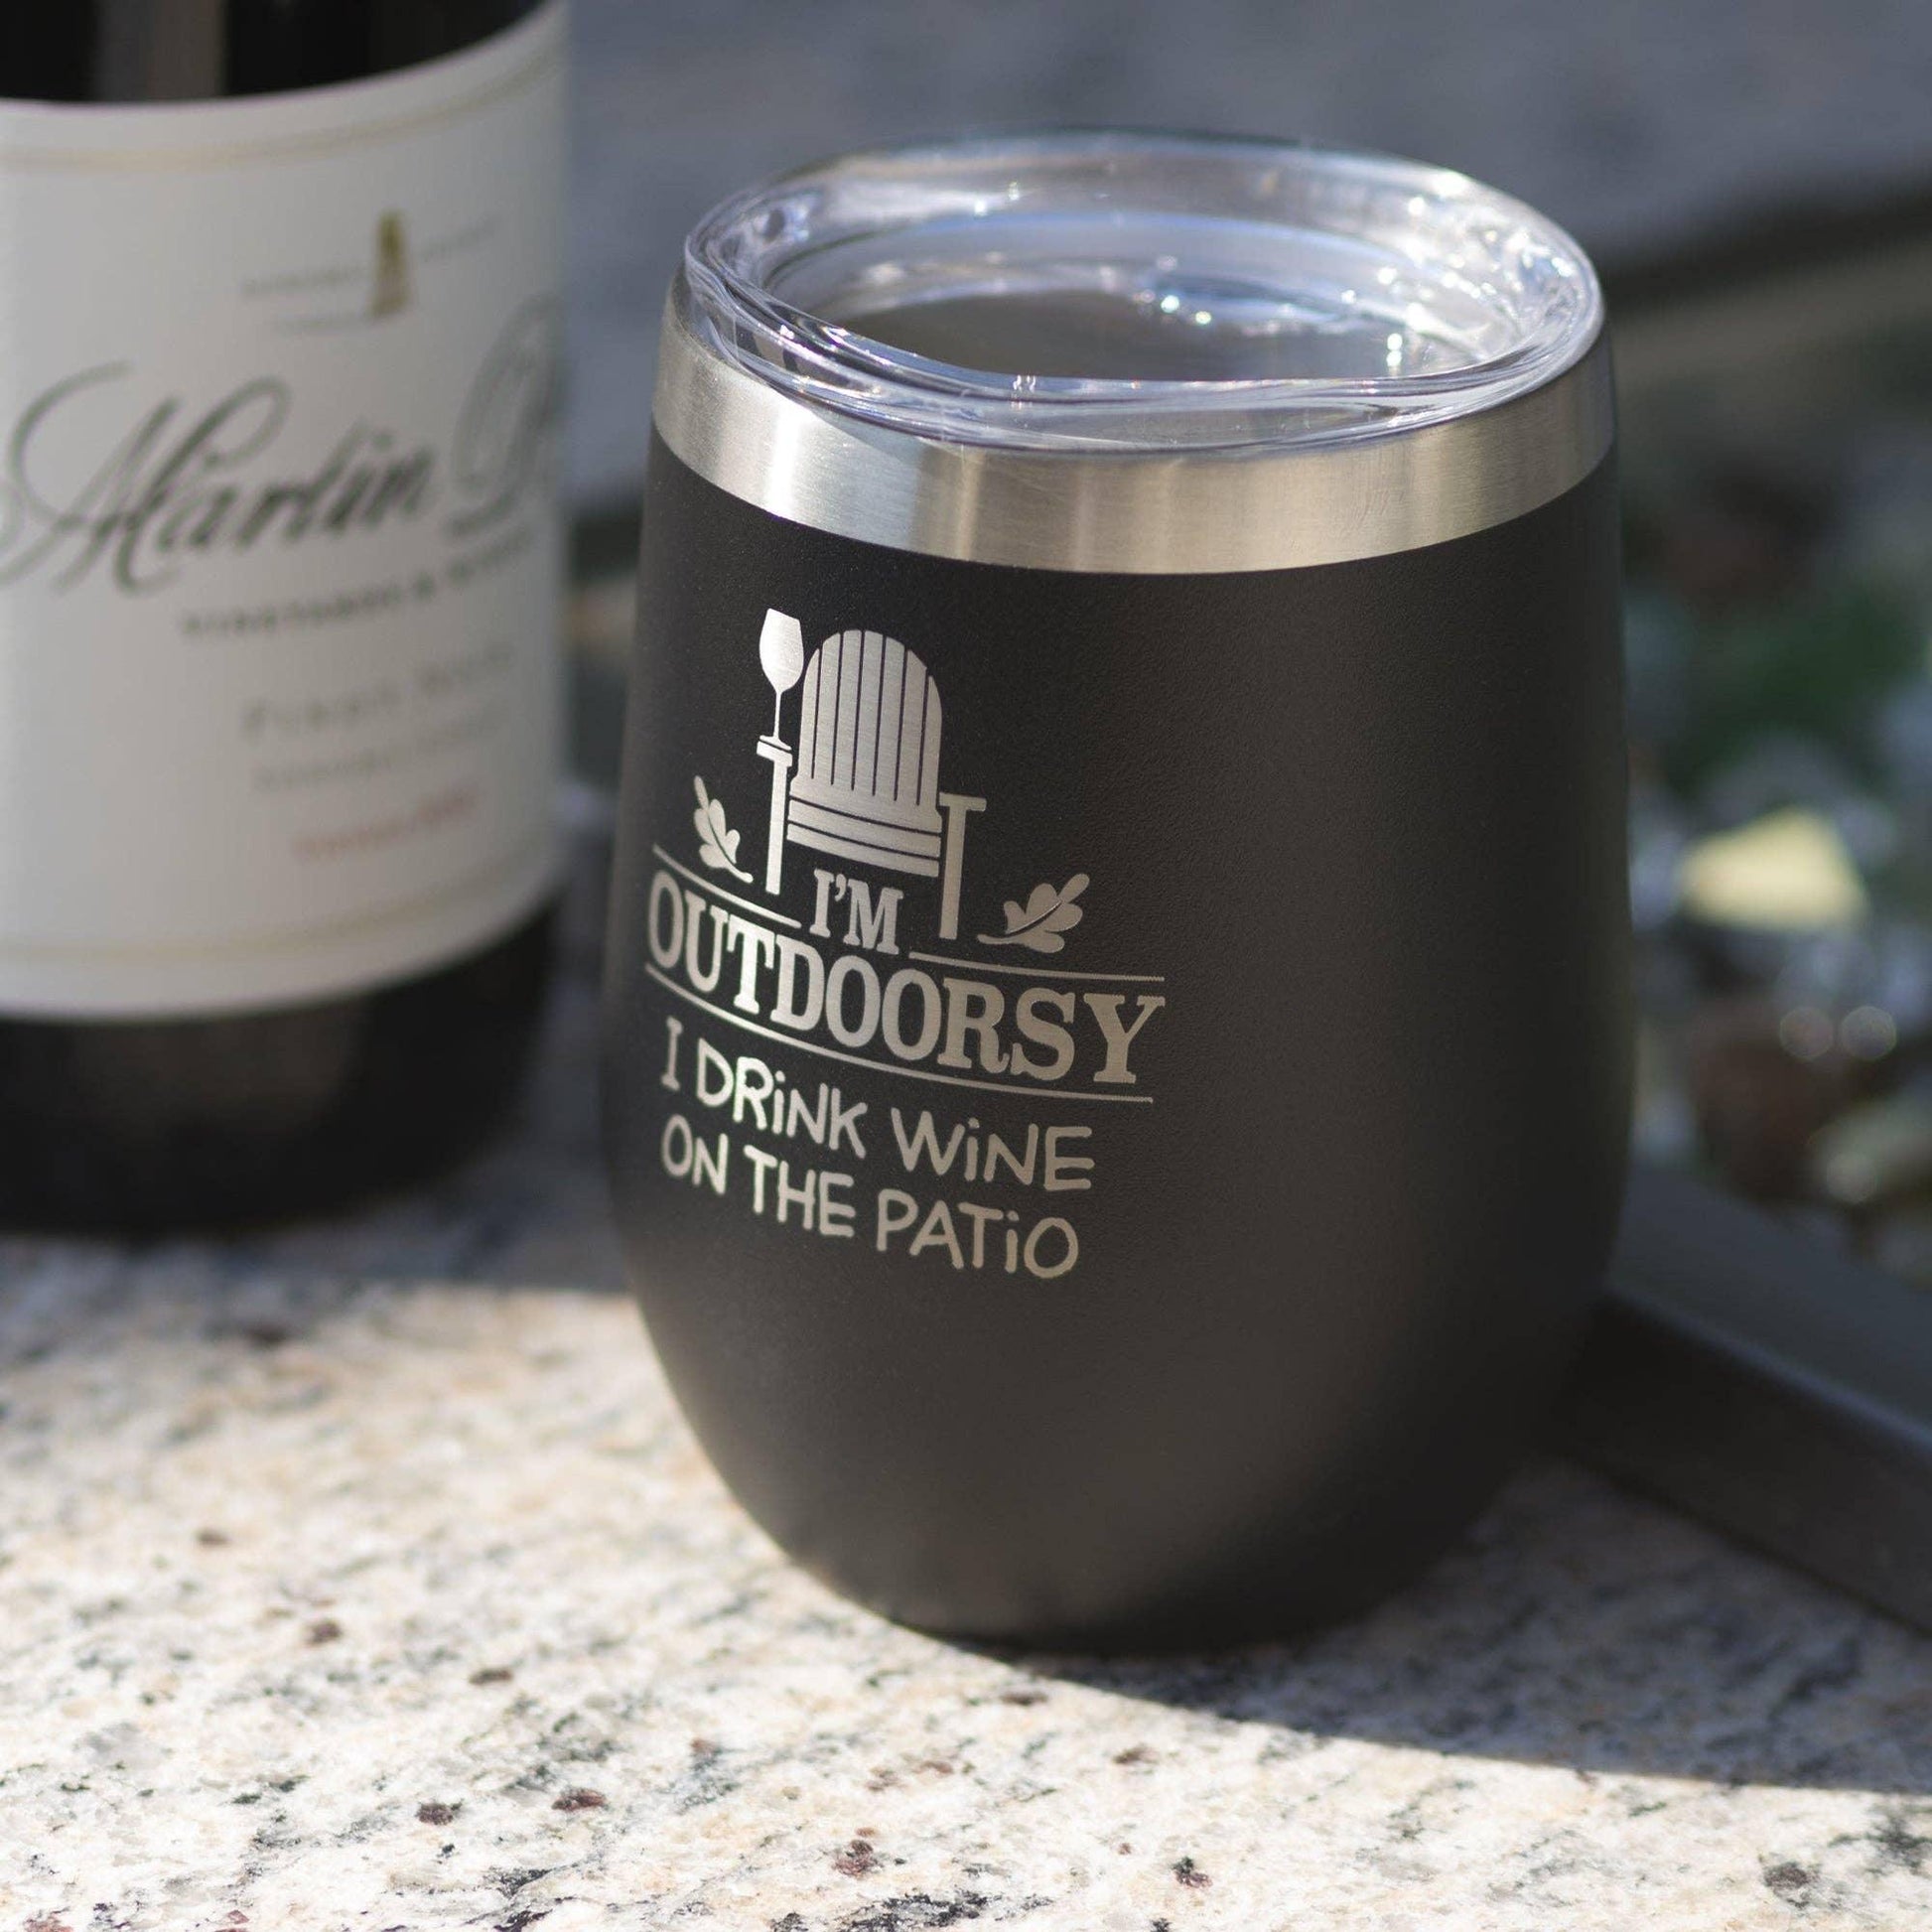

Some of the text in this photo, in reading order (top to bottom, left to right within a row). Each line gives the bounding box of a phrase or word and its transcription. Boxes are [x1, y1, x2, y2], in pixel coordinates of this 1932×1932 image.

[809, 867, 903, 955] I'M
[647, 870, 1167, 1085] OUTDOORSY
[660, 1016, 684, 1091] I
[660, 1113, 730, 1194] ON
[743, 1144, 856, 1238] THE
